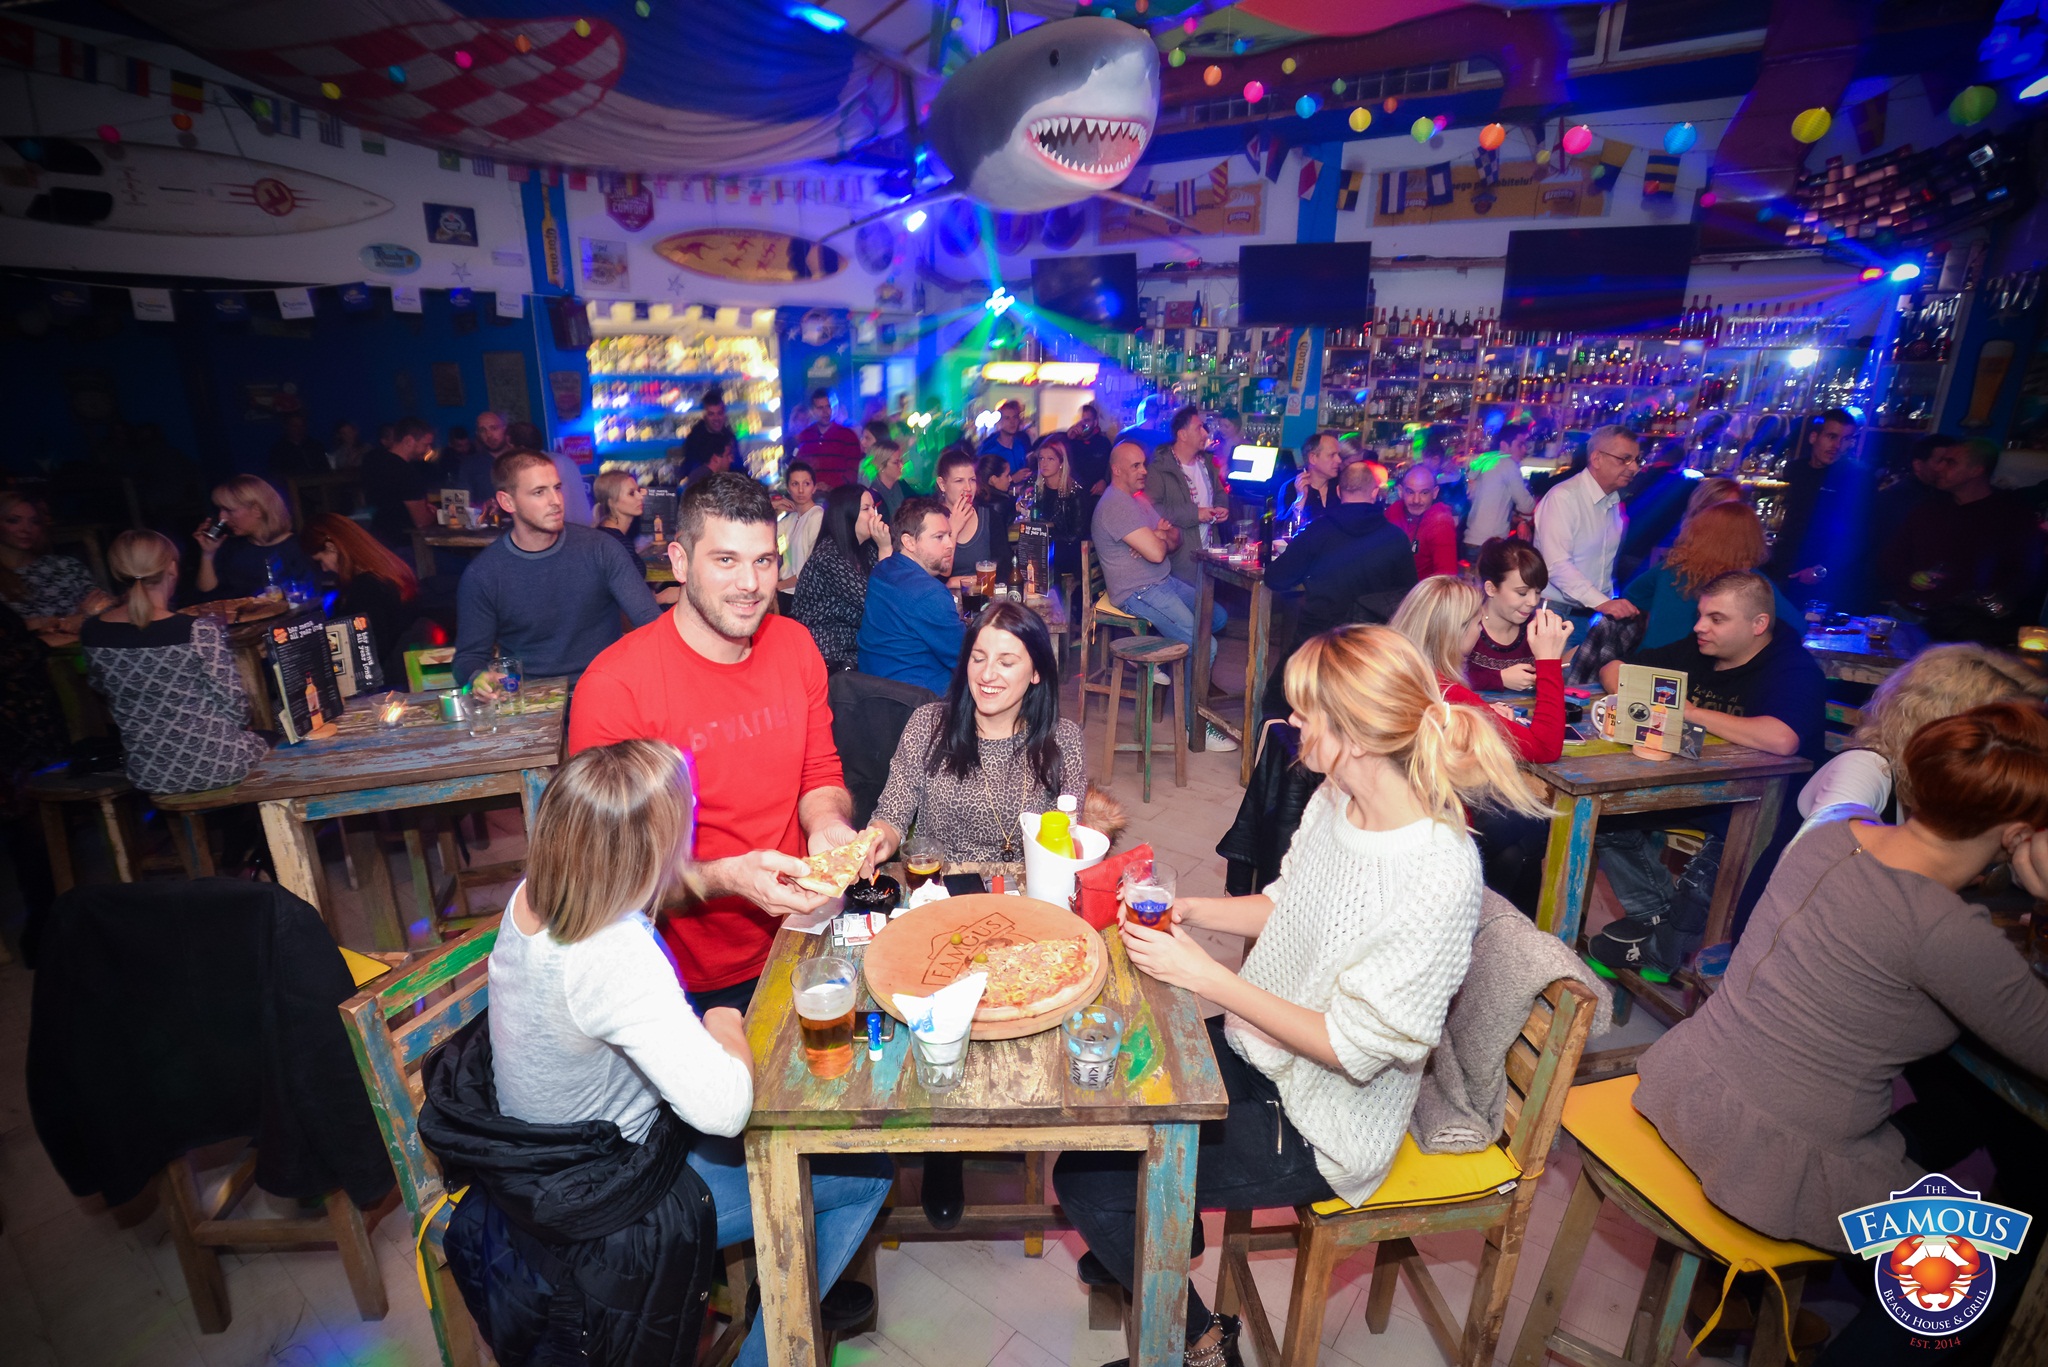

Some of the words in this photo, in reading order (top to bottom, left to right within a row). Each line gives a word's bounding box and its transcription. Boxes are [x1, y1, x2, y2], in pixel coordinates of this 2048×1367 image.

[545, 227, 560, 275] Corona
[1296, 340, 1309, 382] Corona
[931, 918, 1003, 980] FAMOUS
[1088, 1066, 1099, 1087] KIKI
